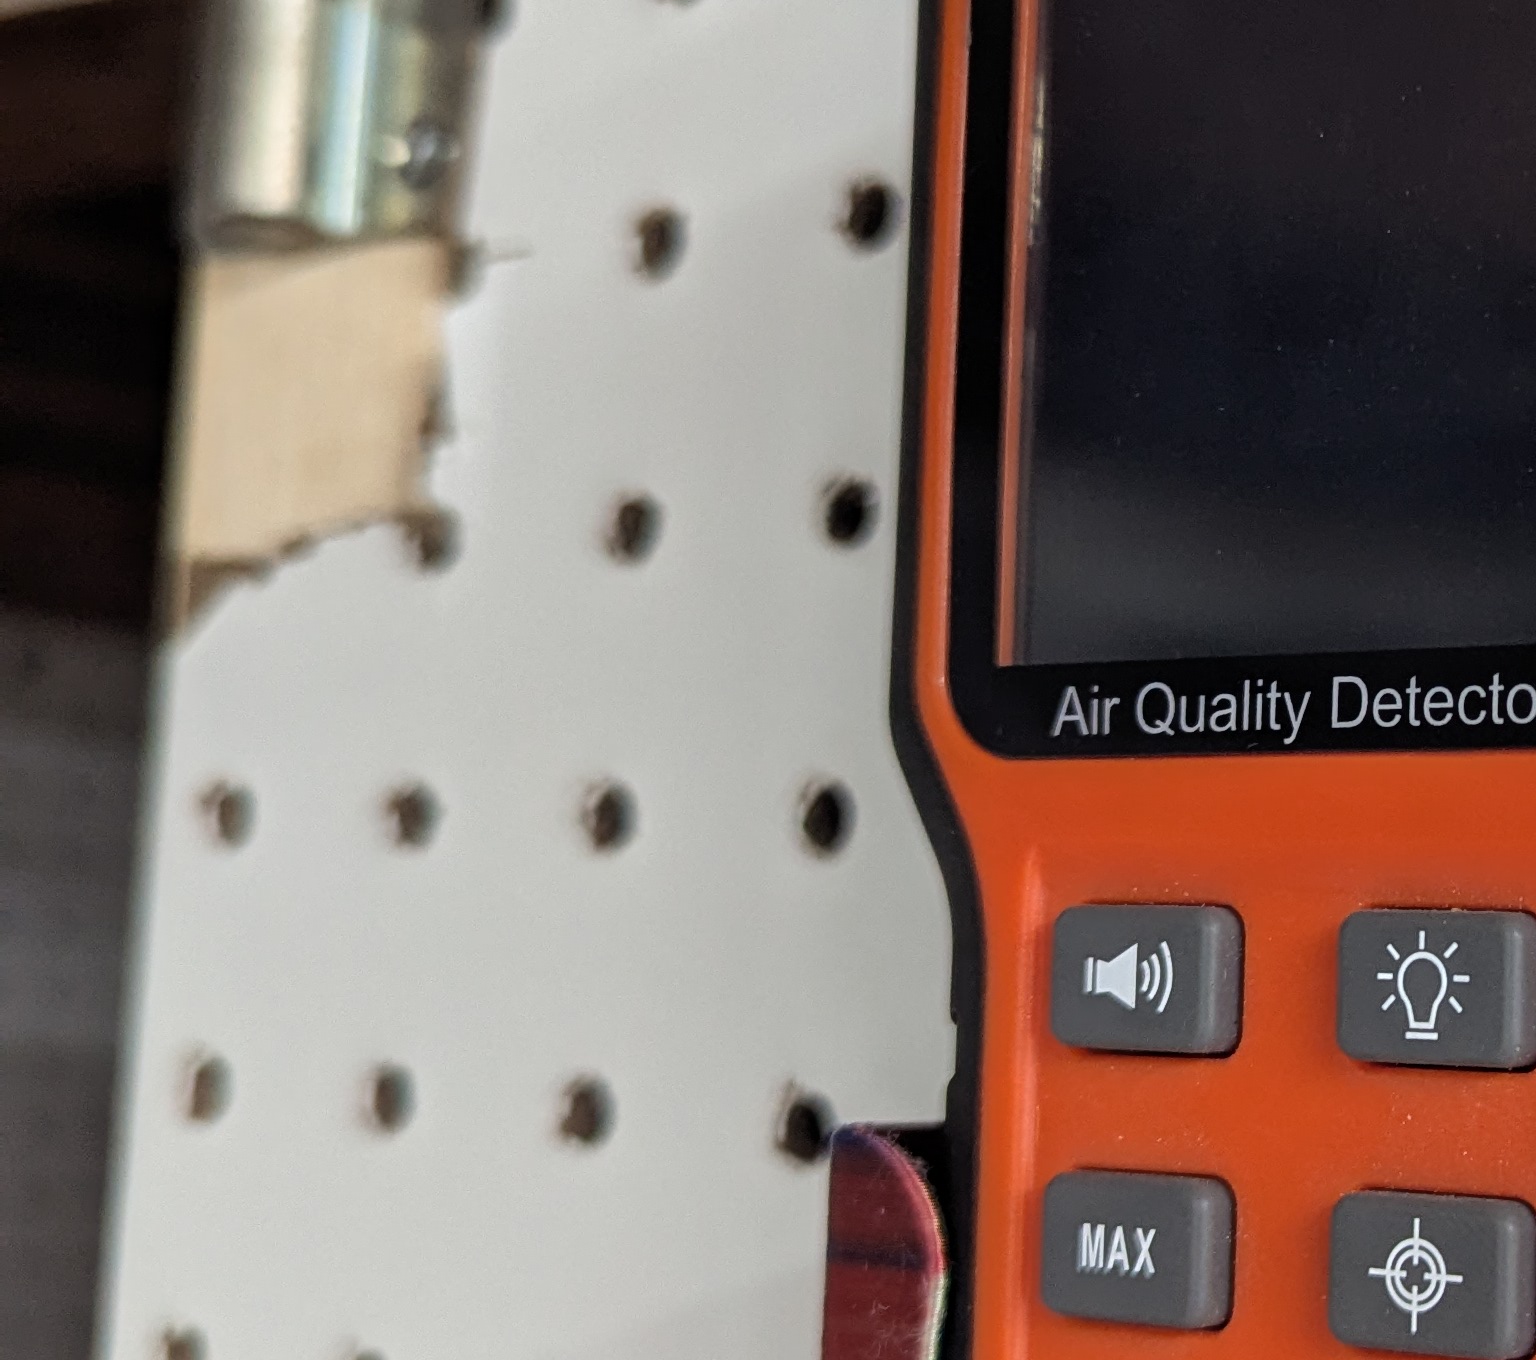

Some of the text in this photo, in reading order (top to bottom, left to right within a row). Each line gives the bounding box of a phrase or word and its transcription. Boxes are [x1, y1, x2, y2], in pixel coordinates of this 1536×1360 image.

[1052, 685, 1119, 736] Air
[1136, 679, 1310, 744] Quality
[1077, 1222, 1156, 1277] MAX
